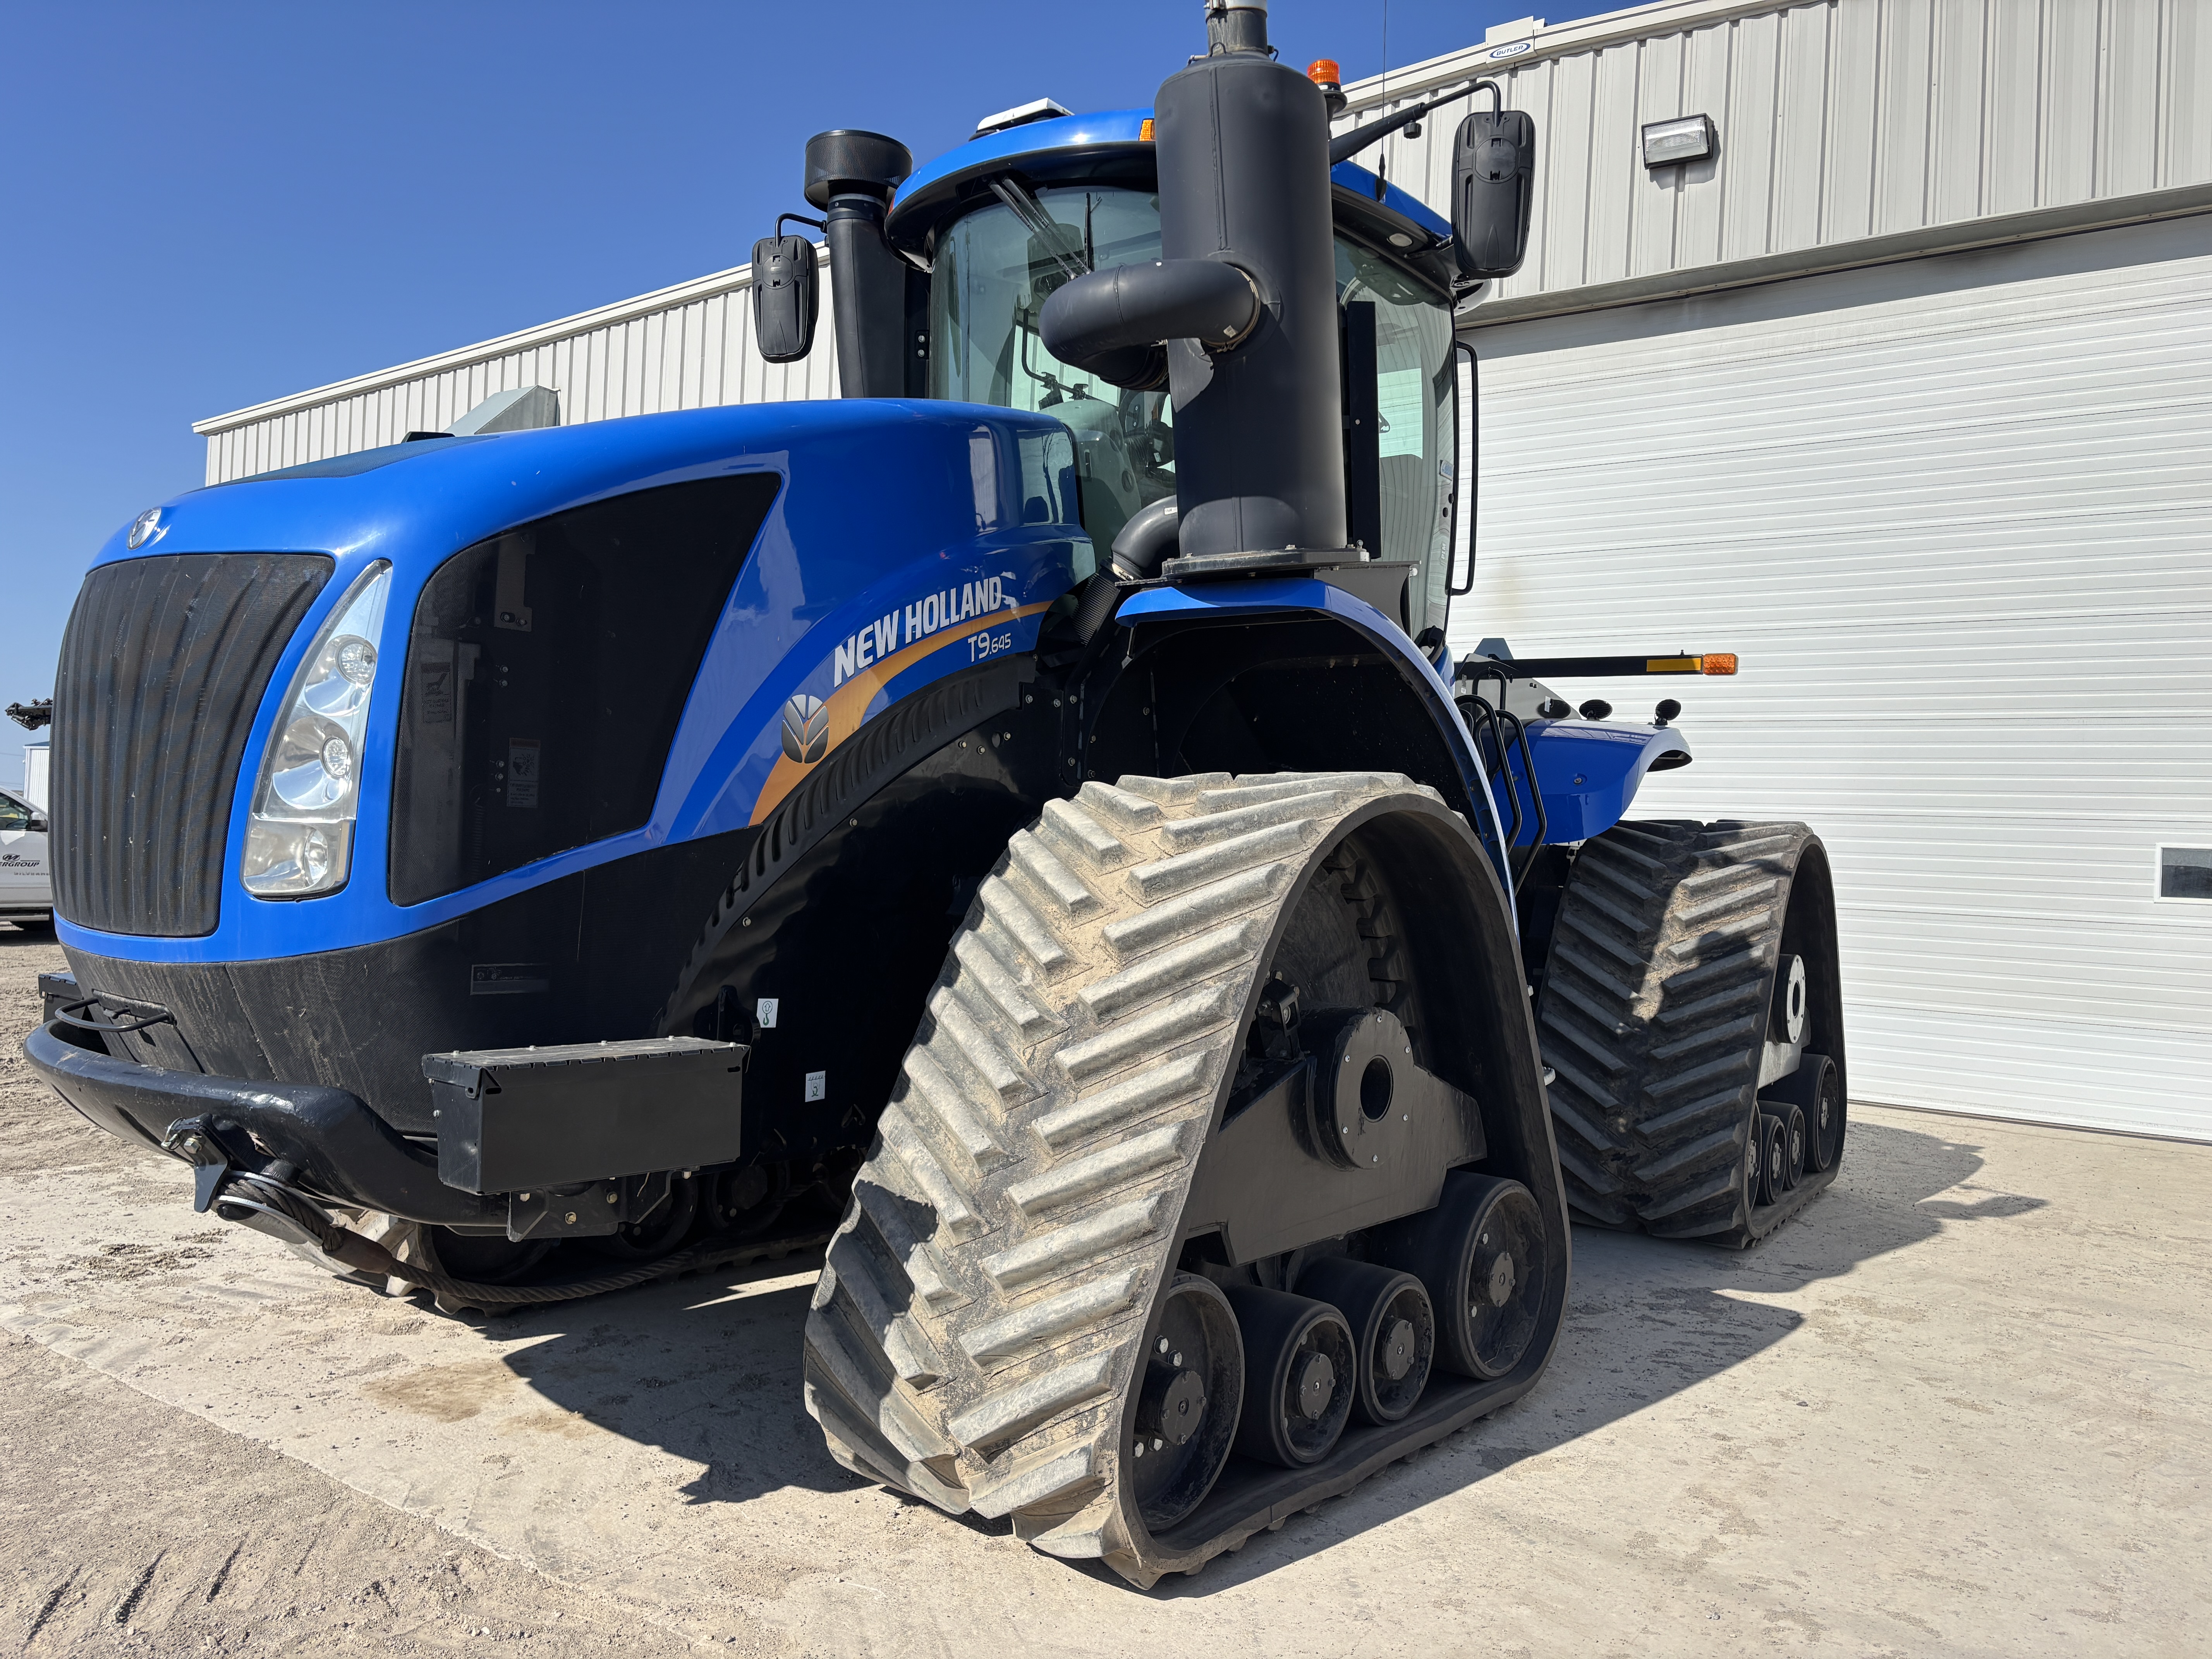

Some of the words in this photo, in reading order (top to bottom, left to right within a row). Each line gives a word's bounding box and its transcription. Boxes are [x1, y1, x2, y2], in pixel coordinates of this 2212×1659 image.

[1496, 45, 1523, 56] BUTLER
[834, 609, 899, 688] NEW
[905, 576, 1002, 644] HOLLAND
[968, 632, 1011, 663] T9.645
